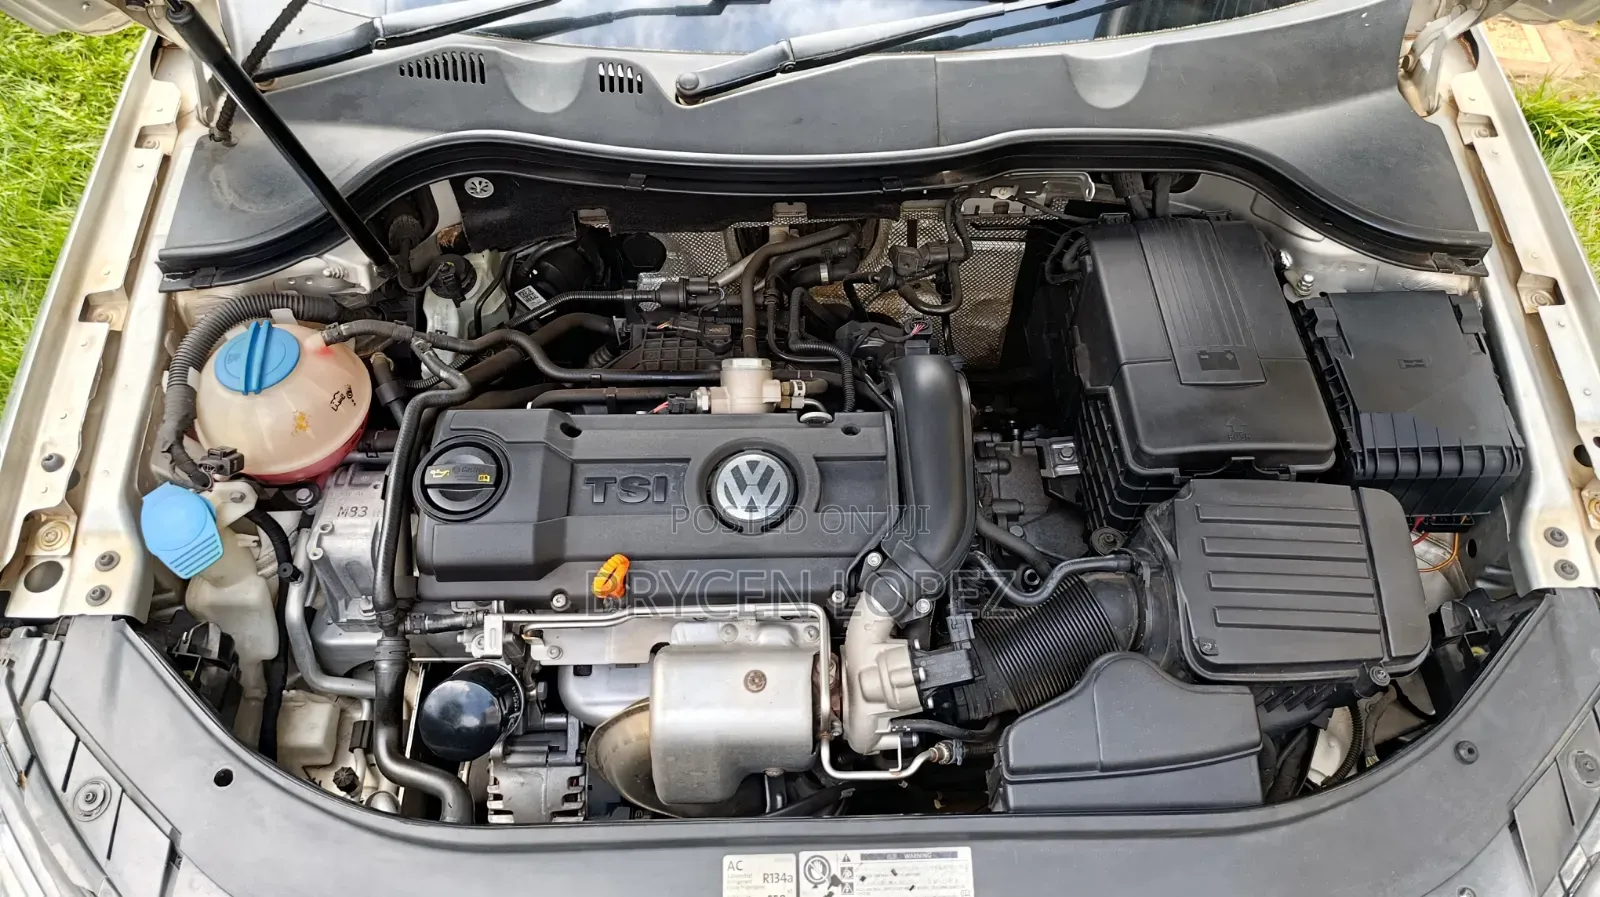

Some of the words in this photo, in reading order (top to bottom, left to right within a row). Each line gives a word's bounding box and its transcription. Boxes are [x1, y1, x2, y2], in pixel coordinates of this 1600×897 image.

[584, 475, 668, 503] TSI
[727, 860, 743, 871] AC
[763, 872, 793, 883] R134a
